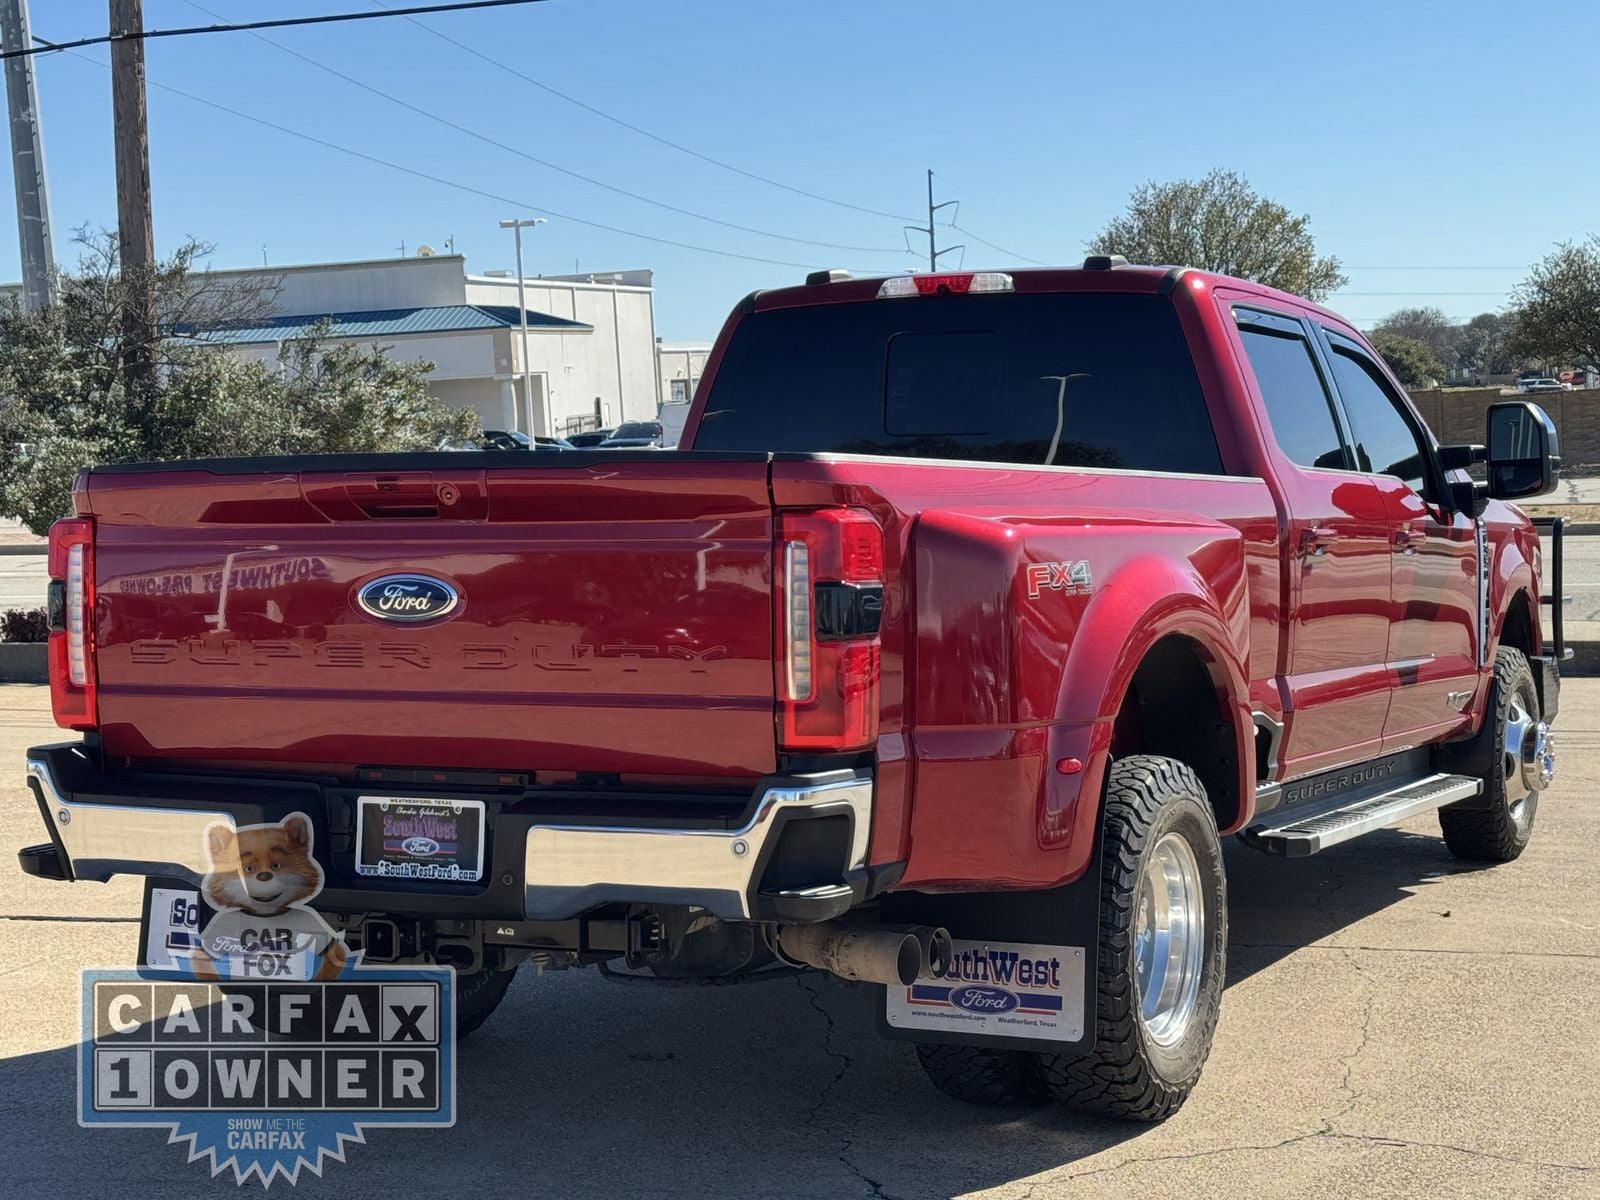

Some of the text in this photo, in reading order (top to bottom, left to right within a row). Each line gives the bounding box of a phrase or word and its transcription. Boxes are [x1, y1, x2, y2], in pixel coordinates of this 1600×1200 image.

[1026, 560, 1093, 600] FX4
[379, 584, 432, 610] Ford
[130, 639, 727, 674] SUPER DUTY
[1286, 760, 1396, 804] SUPER DUTY
[409, 841, 431, 853] Ford
[945, 949, 1060, 989] uthWest
[961, 989, 1007, 1009] Ford
[1039, 1020, 1057, 1028] Texas
